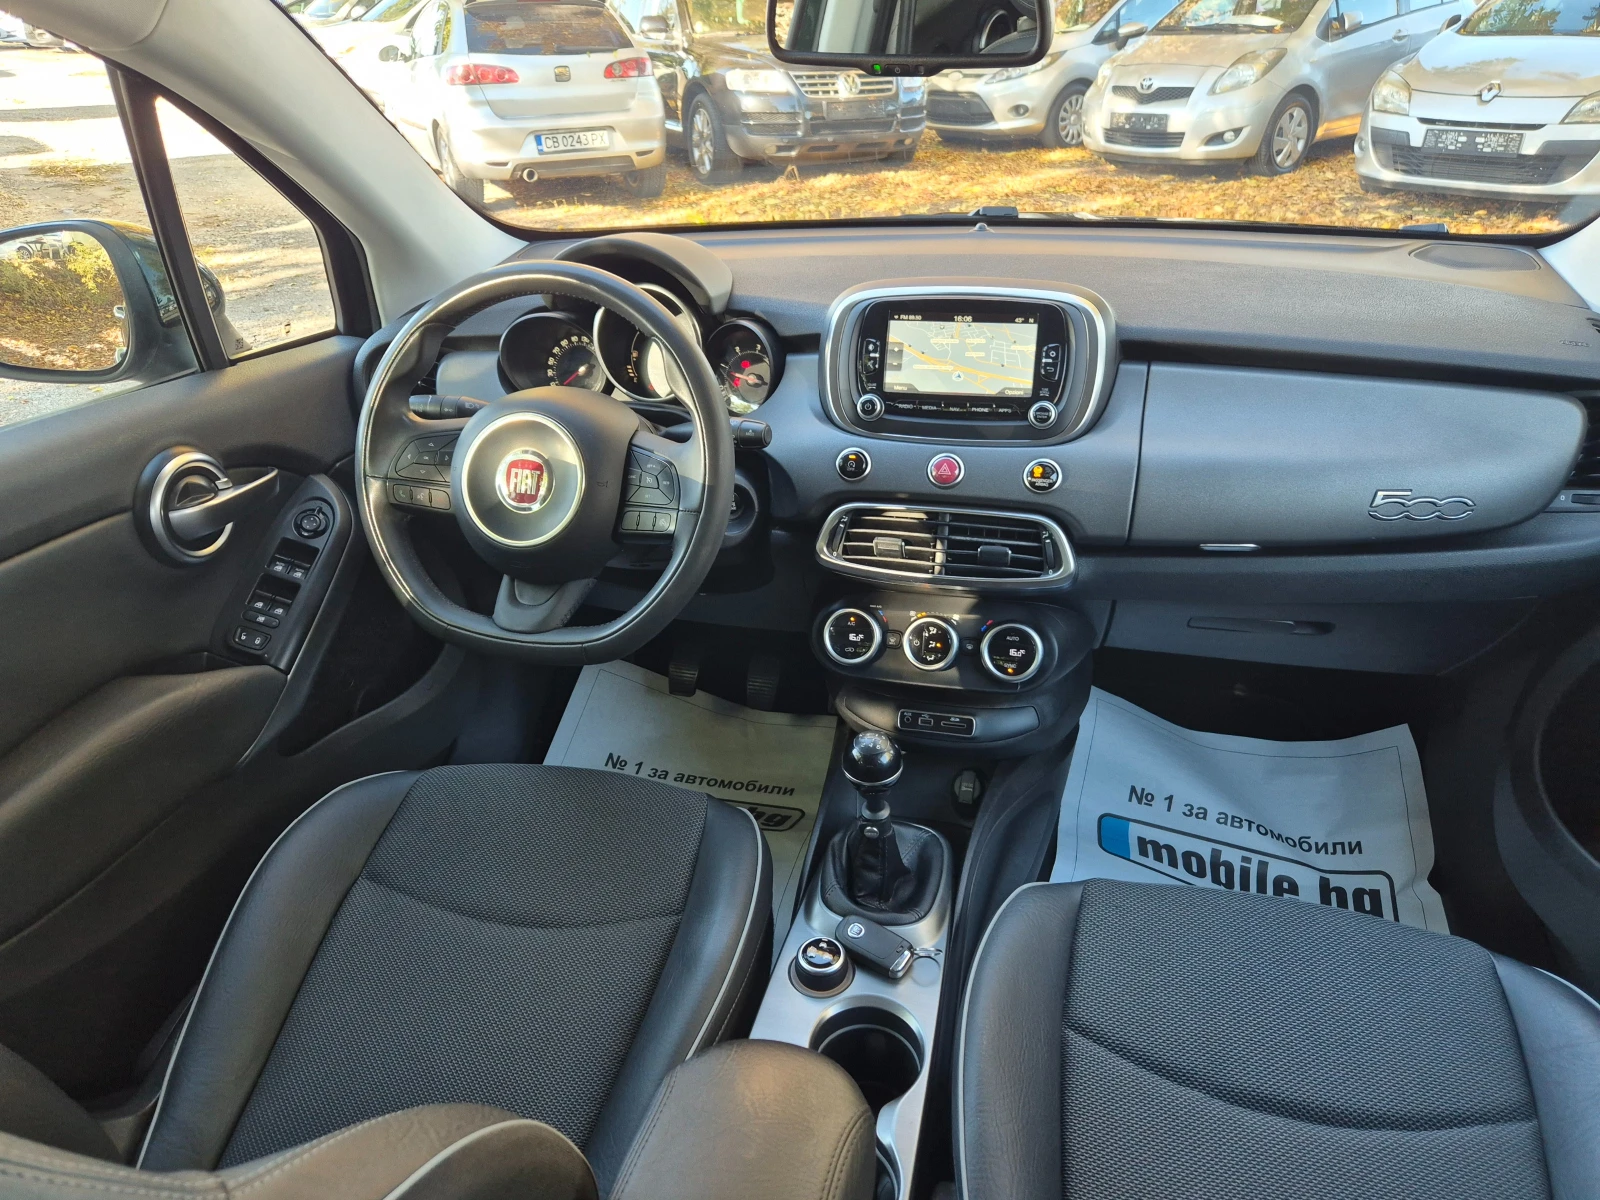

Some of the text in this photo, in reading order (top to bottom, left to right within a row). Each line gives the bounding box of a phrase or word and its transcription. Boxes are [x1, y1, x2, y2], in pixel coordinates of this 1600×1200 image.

[544, 132, 606, 149] CB 0243 PX
[953, 315, 973, 323] 16:06
[509, 468, 541, 495] FIAT
[1368, 489, 1476, 522] 500
[634, 761, 644, 775] 1
[647, 767, 670, 780] за
[673, 771, 796, 797] автомобили
[1163, 794, 1174, 813] 1
[1181, 803, 1208, 821] за
[1215, 812, 1363, 856] автомобили
